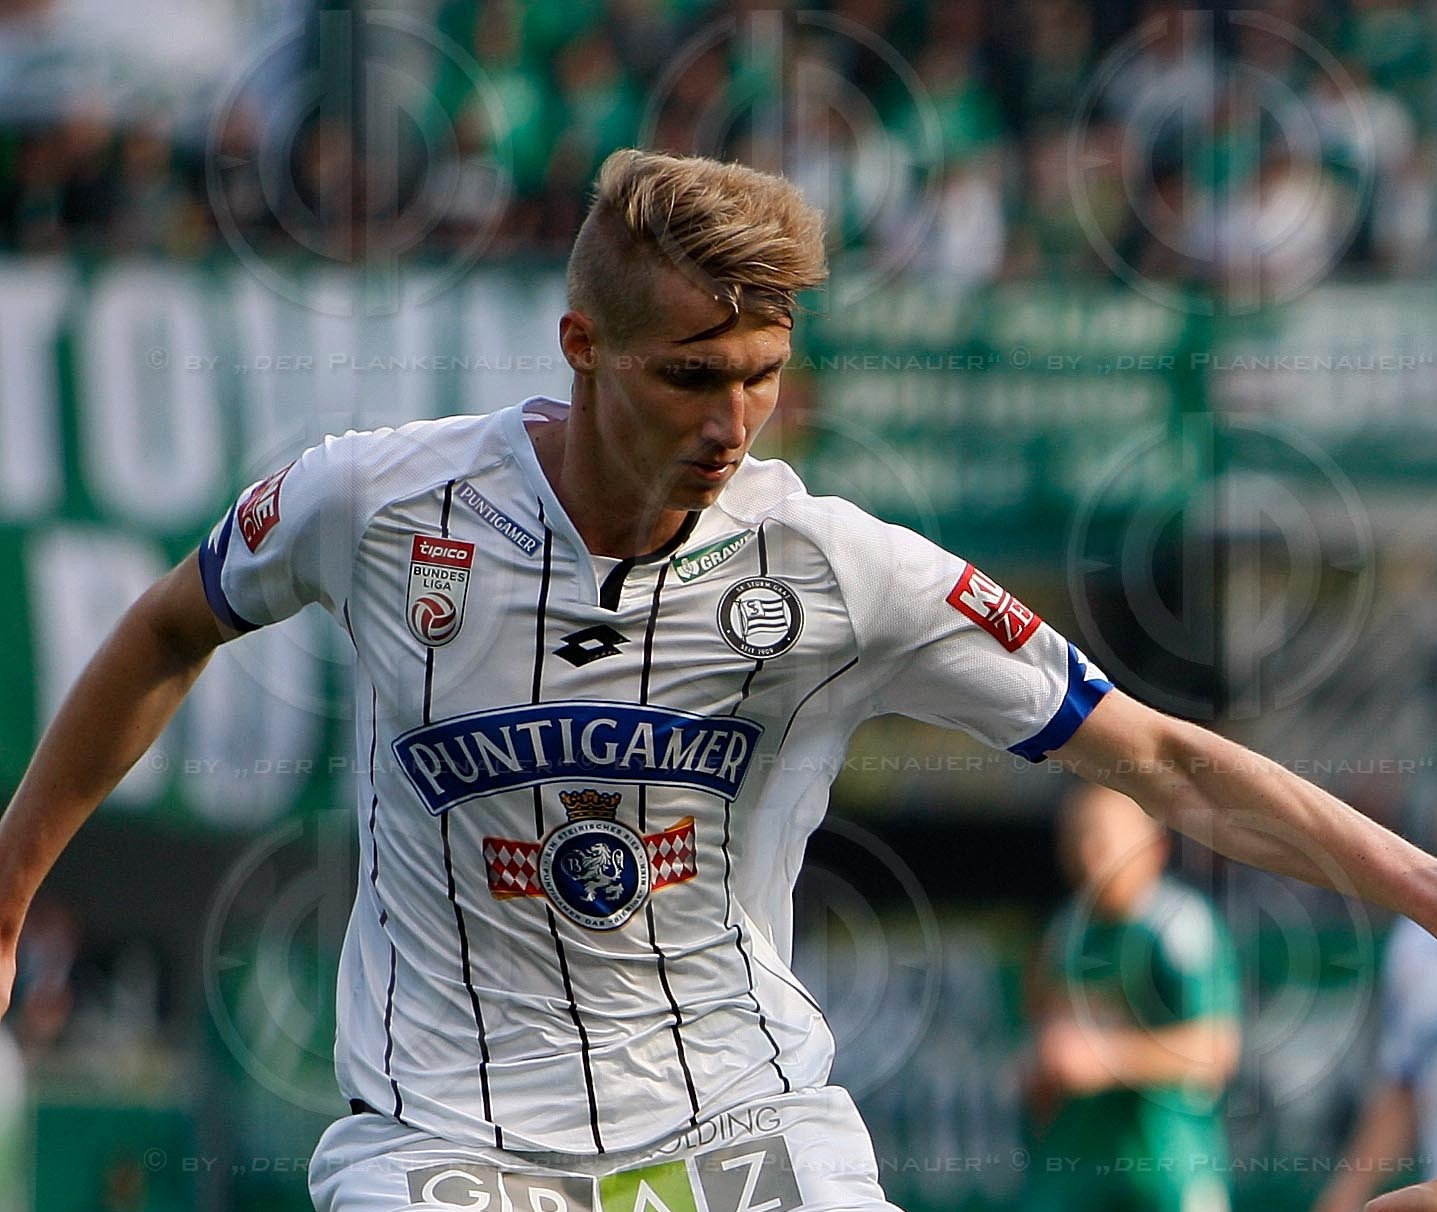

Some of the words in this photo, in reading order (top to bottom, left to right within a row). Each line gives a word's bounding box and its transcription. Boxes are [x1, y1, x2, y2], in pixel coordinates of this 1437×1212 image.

[461, 486, 537, 553] PUNTIGAMER
[419, 540, 467, 560] tipico
[413, 565, 465, 583] BUNDES
[423, 579, 452, 591] LIGA
[408, 718, 748, 796] PUNTIGAMER
[653, 1106, 781, 1155] OLDING
